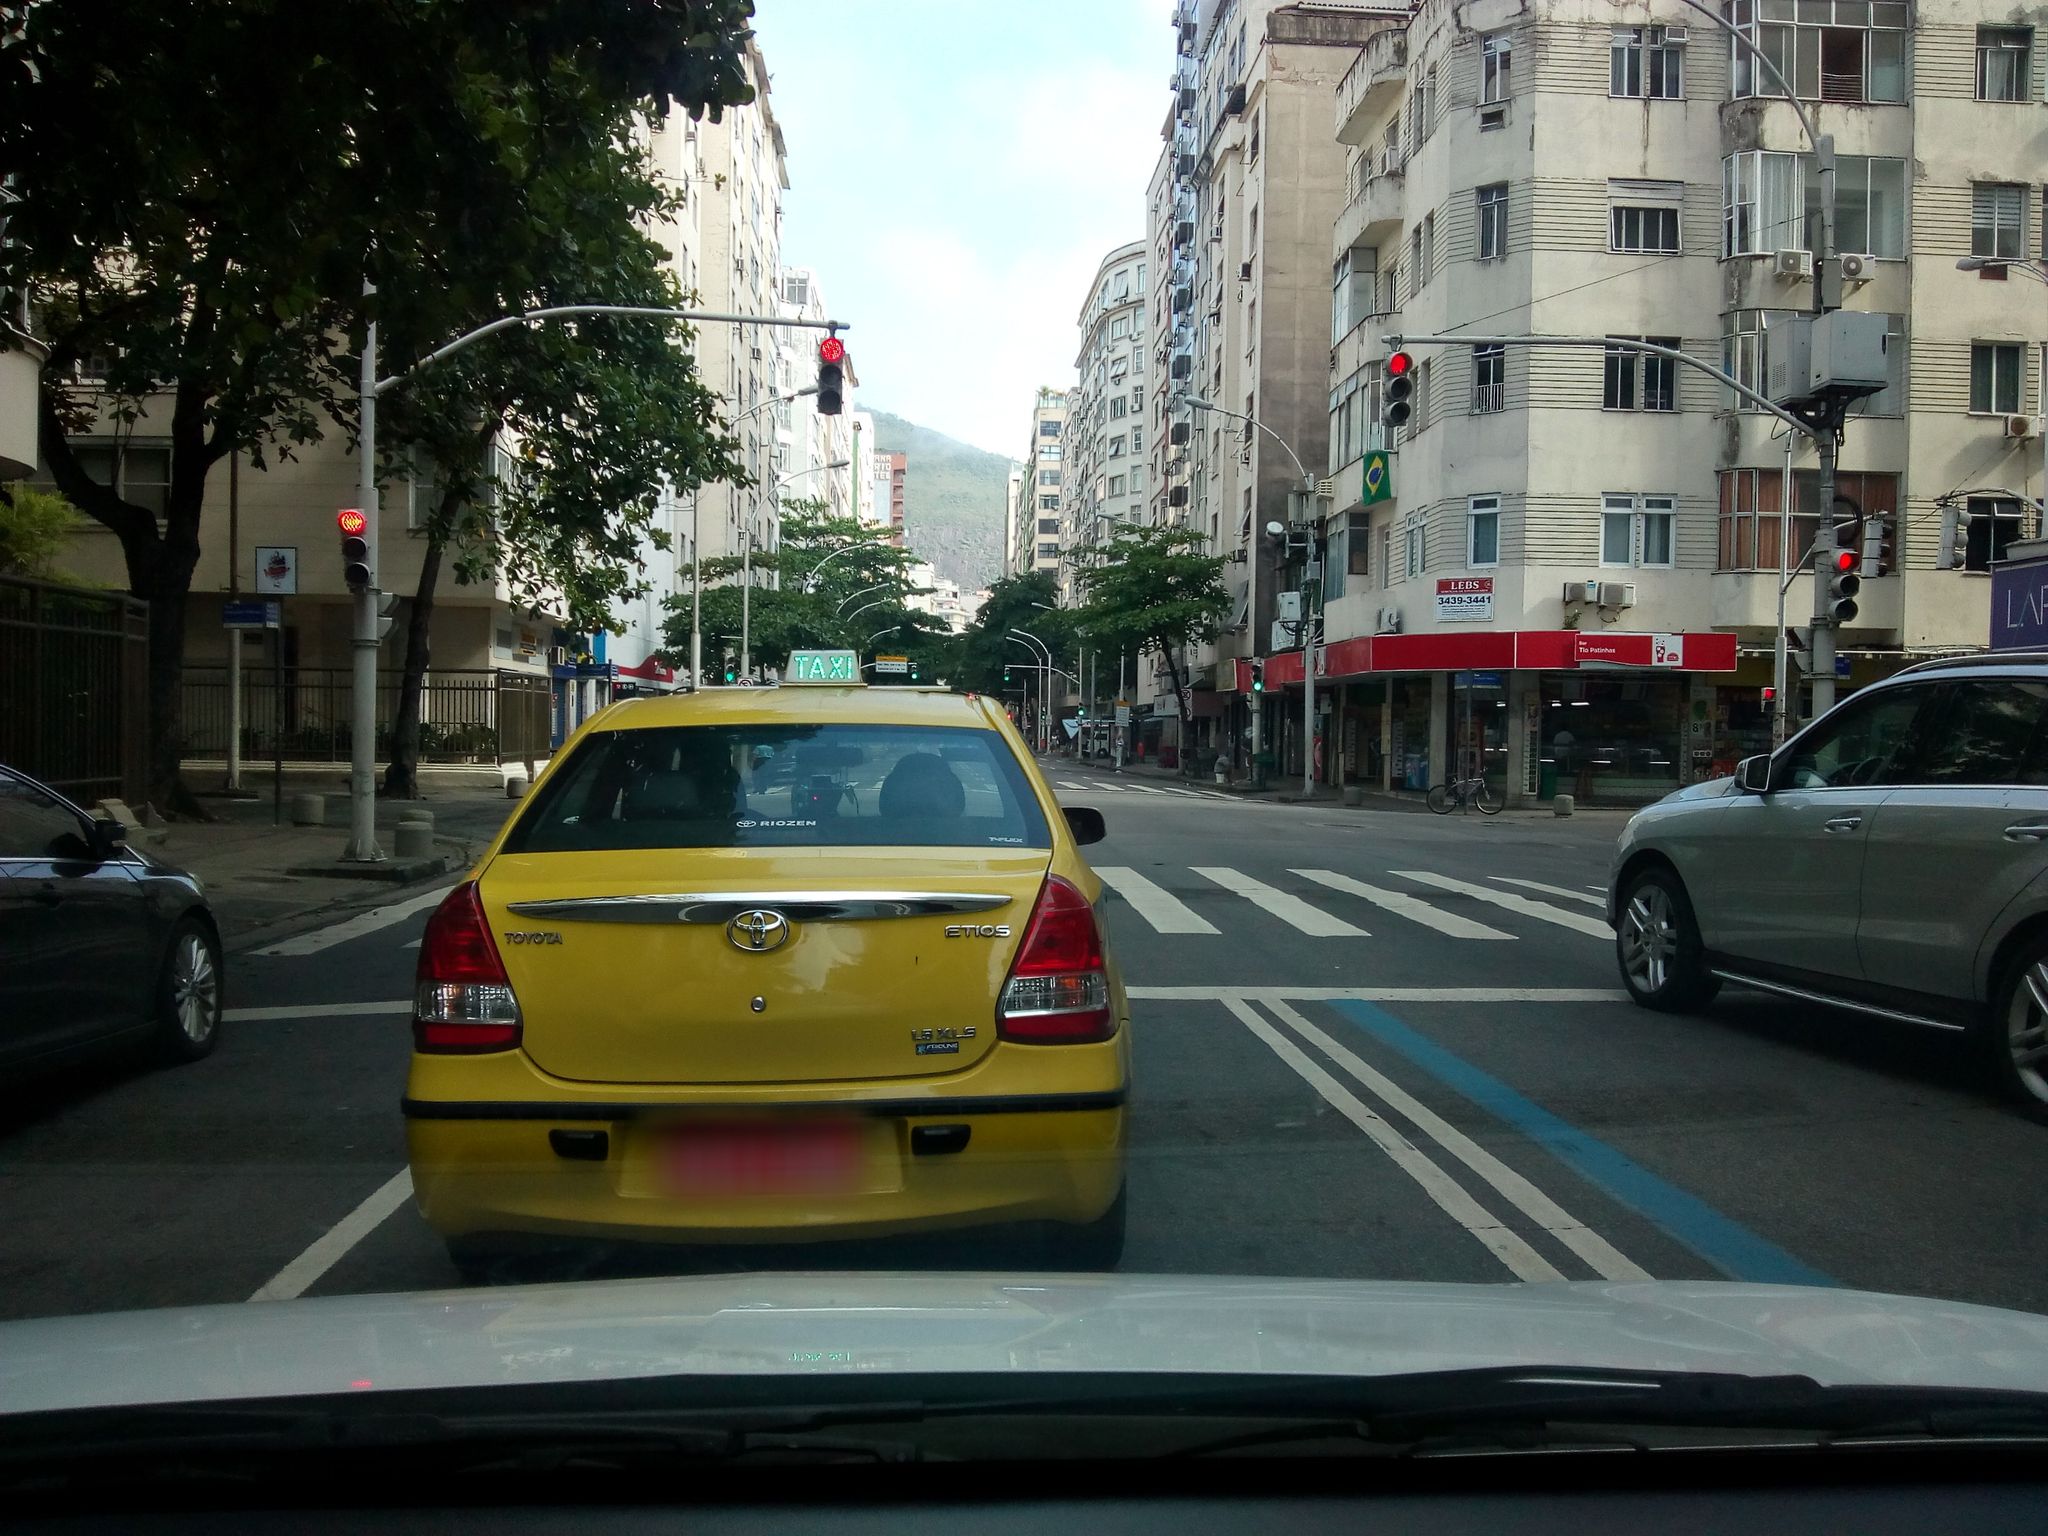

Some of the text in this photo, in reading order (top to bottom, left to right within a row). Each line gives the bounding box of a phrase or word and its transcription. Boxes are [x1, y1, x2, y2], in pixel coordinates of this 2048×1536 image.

[1451, 581, 1480, 590] LEBS
[1438, 596, 1491, 605] 3439-3441
[794, 656, 852, 680] TAXI
[504, 931, 563, 945] TOYOTA
[945, 924, 1011, 938] ETIOS
